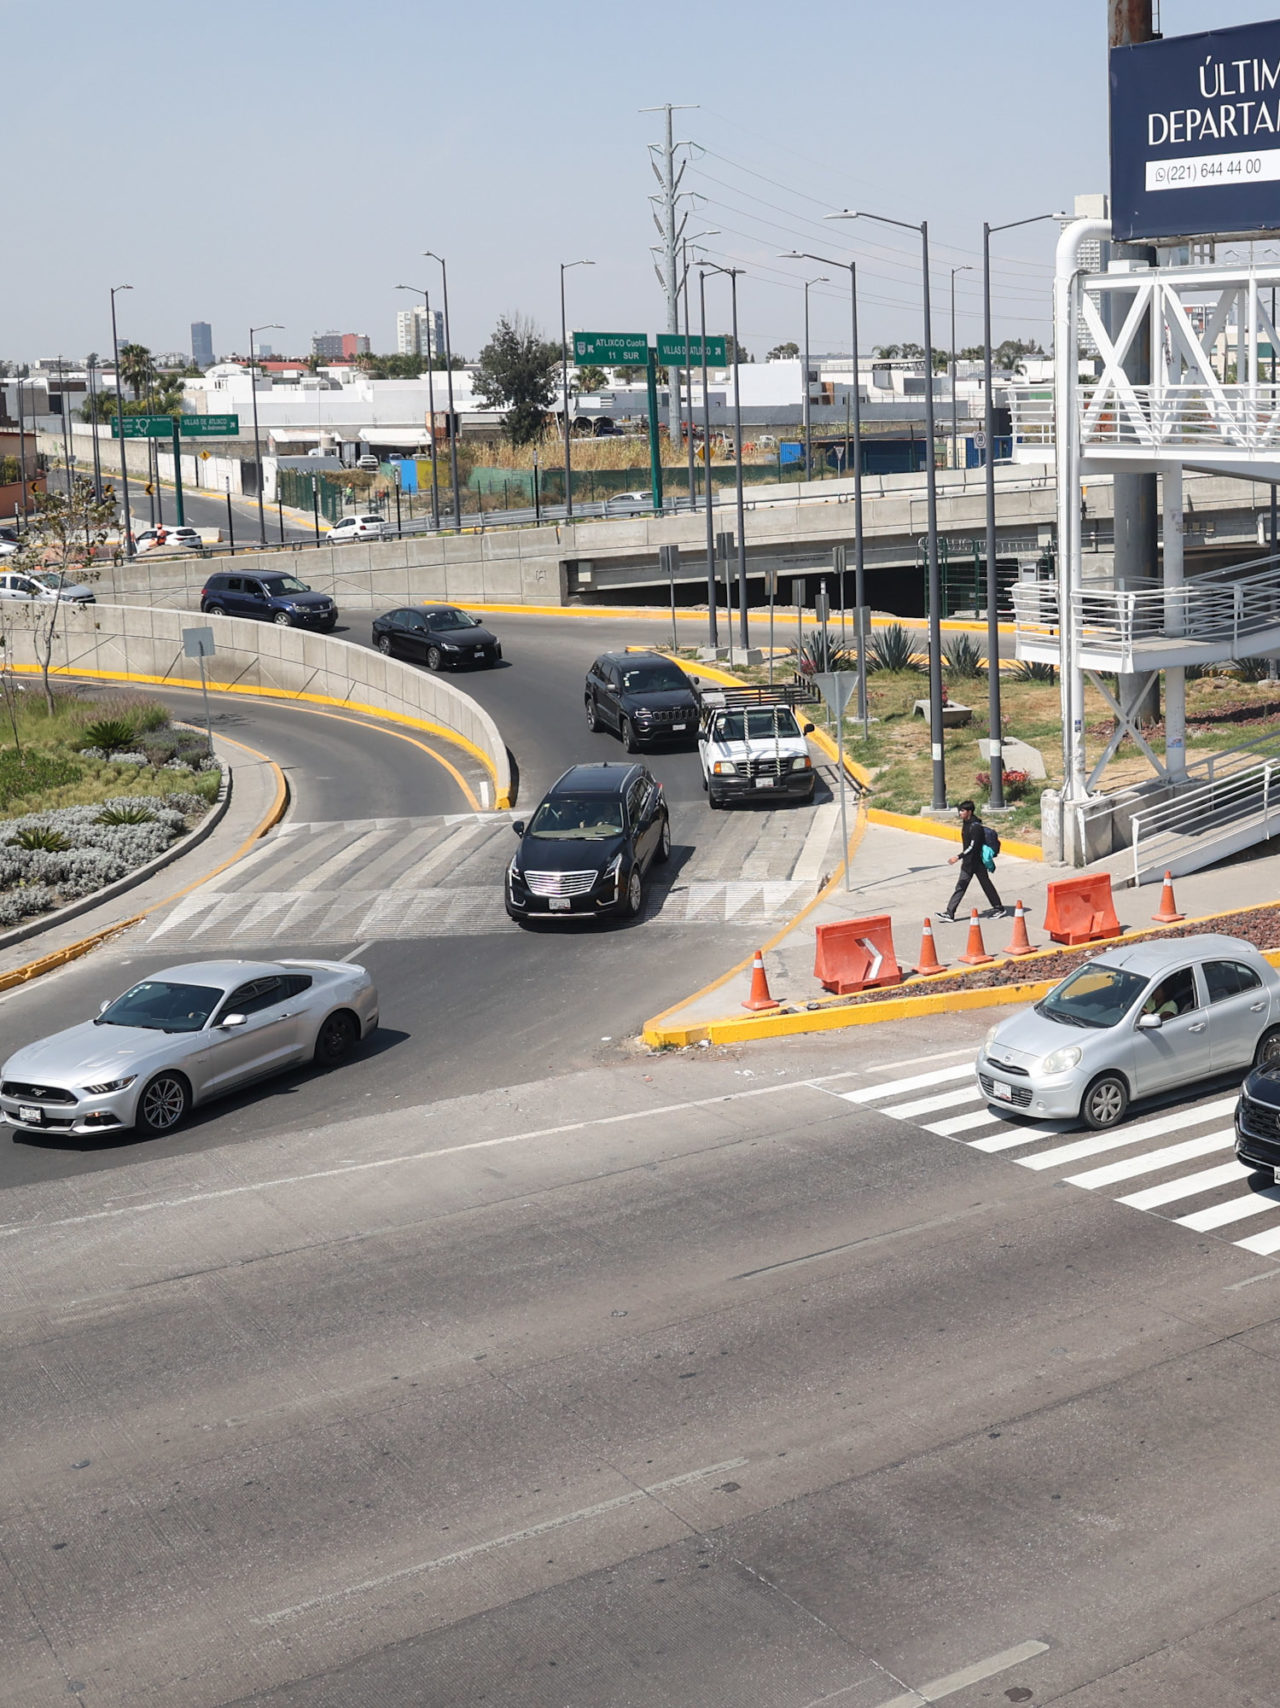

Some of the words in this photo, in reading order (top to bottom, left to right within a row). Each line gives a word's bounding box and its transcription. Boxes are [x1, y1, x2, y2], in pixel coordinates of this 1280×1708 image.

[1166, 163, 1197, 181] (221)
[1200, 162, 1223, 178] 644
[1227, 160, 1242, 175] 44
[1245, 158, 1261, 174] 00
[596, 339, 624, 347] ATLIXCO
[626, 339, 645, 347] Cuota
[663, 346, 681, 355] VILLAS
[690, 346, 711, 355] ATLICO
